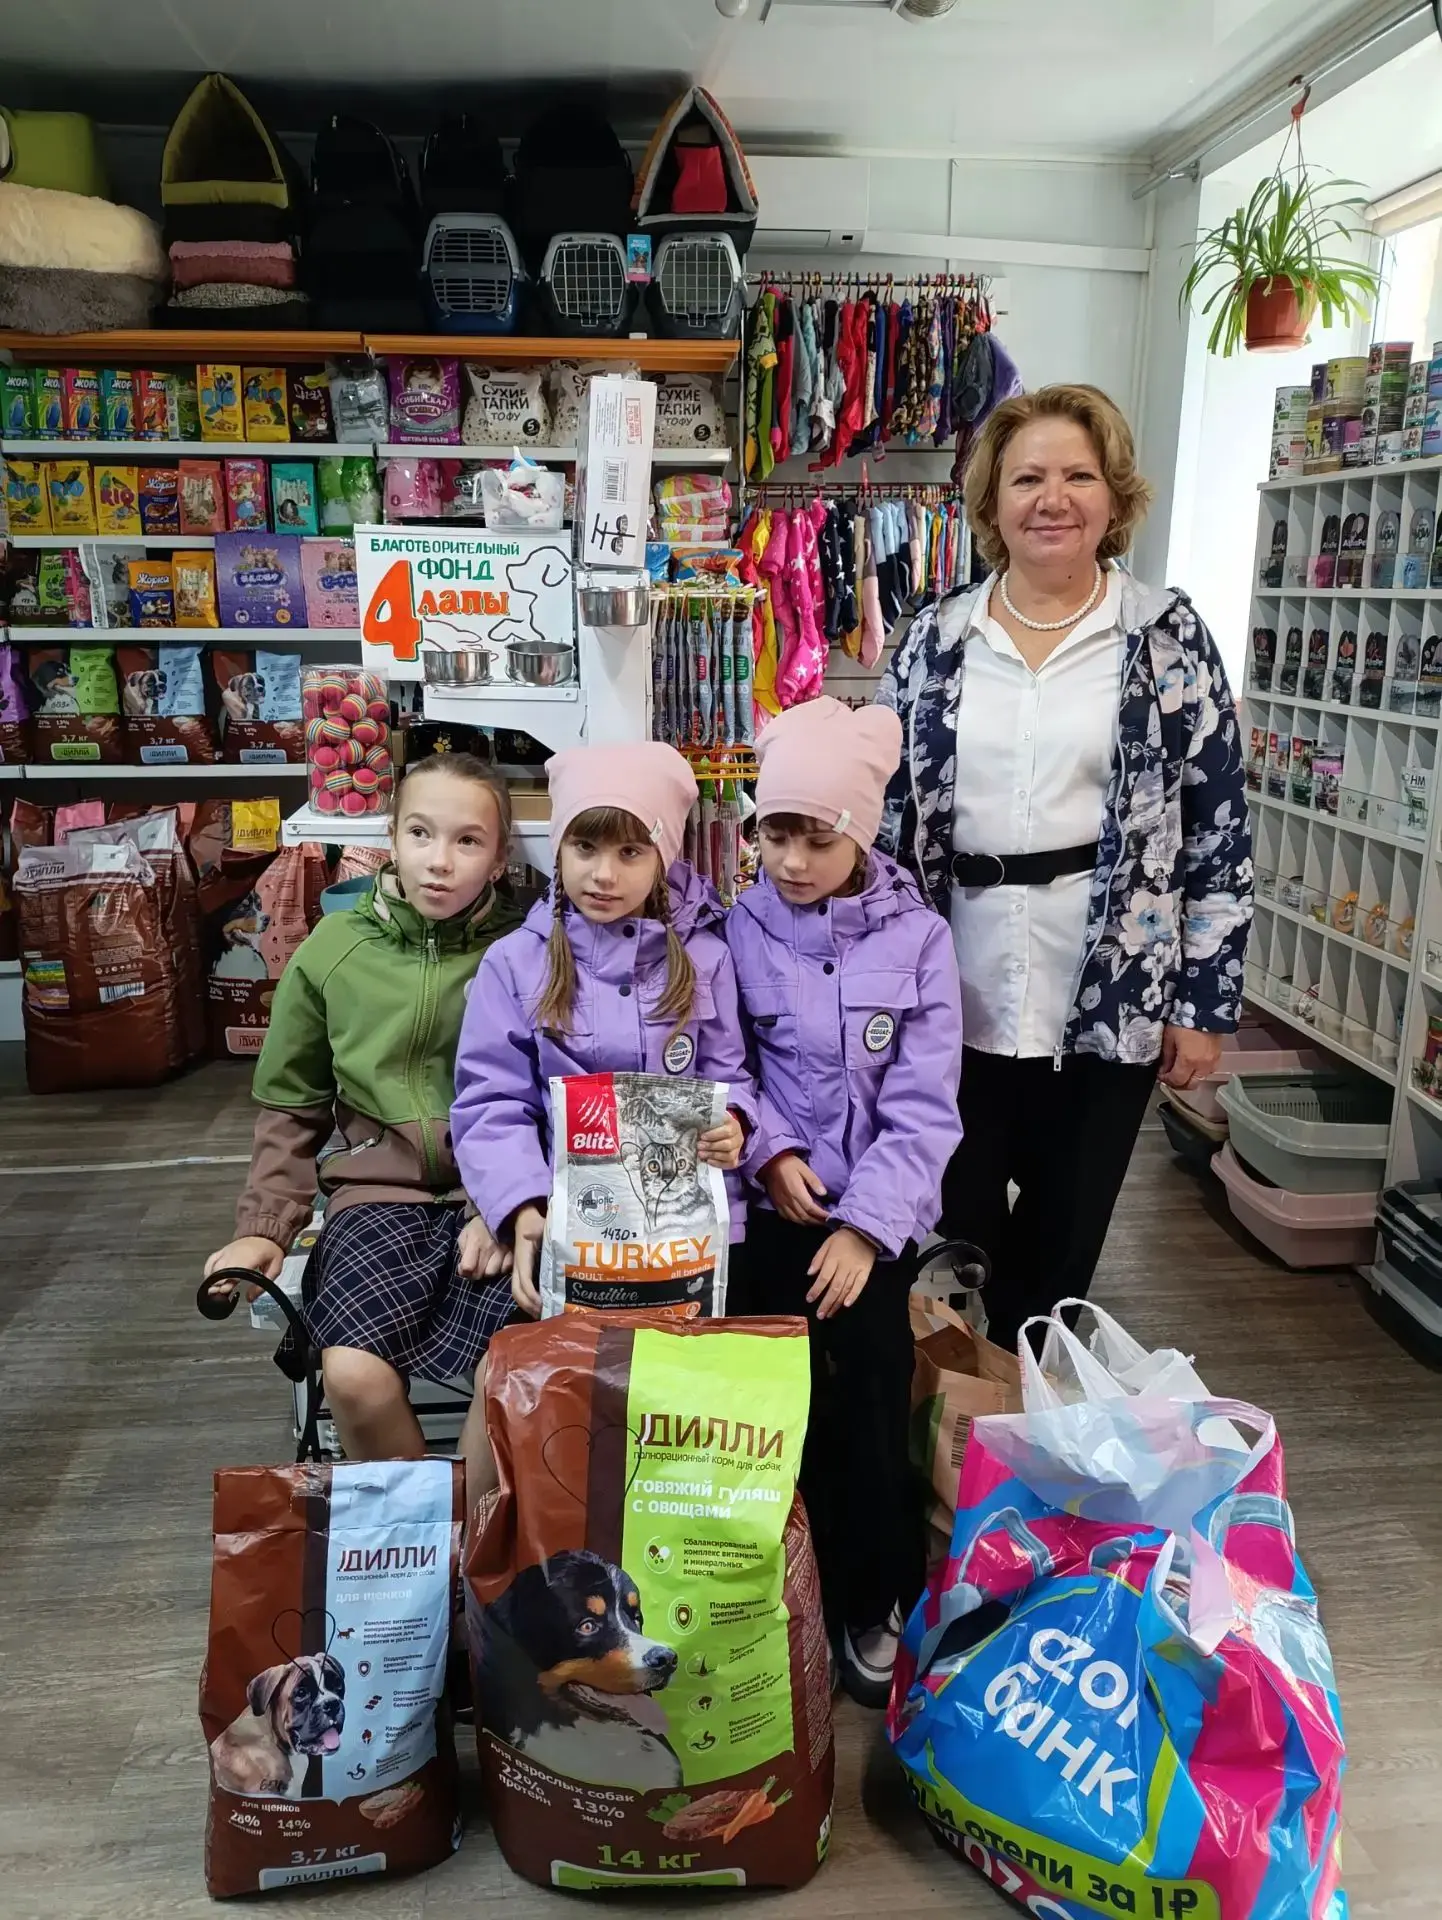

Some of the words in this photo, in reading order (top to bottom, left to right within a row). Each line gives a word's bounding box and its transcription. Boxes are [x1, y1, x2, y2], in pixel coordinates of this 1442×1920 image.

[481, 396, 529, 410] ТАПКИ
[657, 388, 701, 402] СУХИЕ
[491, 411, 521, 422] ТОФУ
[656, 403, 702, 415] ТАПКИ
[526, 419, 536, 432] 5
[665, 416, 693, 426] ТОФУ
[370, 537, 520, 556] БЛАГОТВОРИТЕЛЬНЫЙ
[417, 556, 495, 581] ФОНД
[137, 572, 170, 588] Жорка
[363, 559, 424, 663] 4
[240, 1012, 257, 1025] 14
[572, 1132, 615, 1150] Blitz
[572, 1235, 712, 1269] TURKEY
[571, 1271, 604, 1281] ADULT
[572, 1281, 639, 1304] Sensitive
[635, 1413, 784, 1460] ДИЛЛИ
[634, 1451, 710, 1464] полнорационный
[712, 1456, 735, 1467] корм
[736, 1460, 753, 1471] для
[755, 1462, 782, 1471] собак
[633, 1478, 713, 1498] говяжий
[718, 1486, 781, 1505] гуляш
[632, 1500, 643, 1512] с
[648, 1500, 732, 1520] овощами
[683, 1538, 758, 1550] Сбалансированный
[337, 1545, 437, 1572] ДИЛЛИ
[683, 1548, 721, 1557] комплекс
[721, 1551, 764, 1560] витаминов
[690, 1558, 744, 1569] минеральных
[335, 1591, 360, 1603] для
[363, 1588, 413, 1603] щенков
[710, 1609, 744, 1619] крепкой
[984, 1661, 1139, 1817] банк
[501, 1760, 545, 1797] 22%
[514, 1758, 584, 1795] взрослых
[587, 1788, 635, 1803] собак
[498, 1772, 552, 1807] протеин
[241, 1801, 259, 1810] для
[261, 1803, 301, 1813] щенков
[572, 1797, 625, 1819] 13%
[277, 1819, 312, 1830] 14%
[581, 1813, 613, 1828] жир
[290, 1847, 328, 1866] 3,7
[335, 1843, 361, 1859] кг
[597, 1844, 645, 1869] 14
[659, 1851, 701, 1869] кг
[935, 1800, 957, 1829] и
[964, 1820, 1073, 1890] отели
[1087, 1873, 1136, 1915] за
